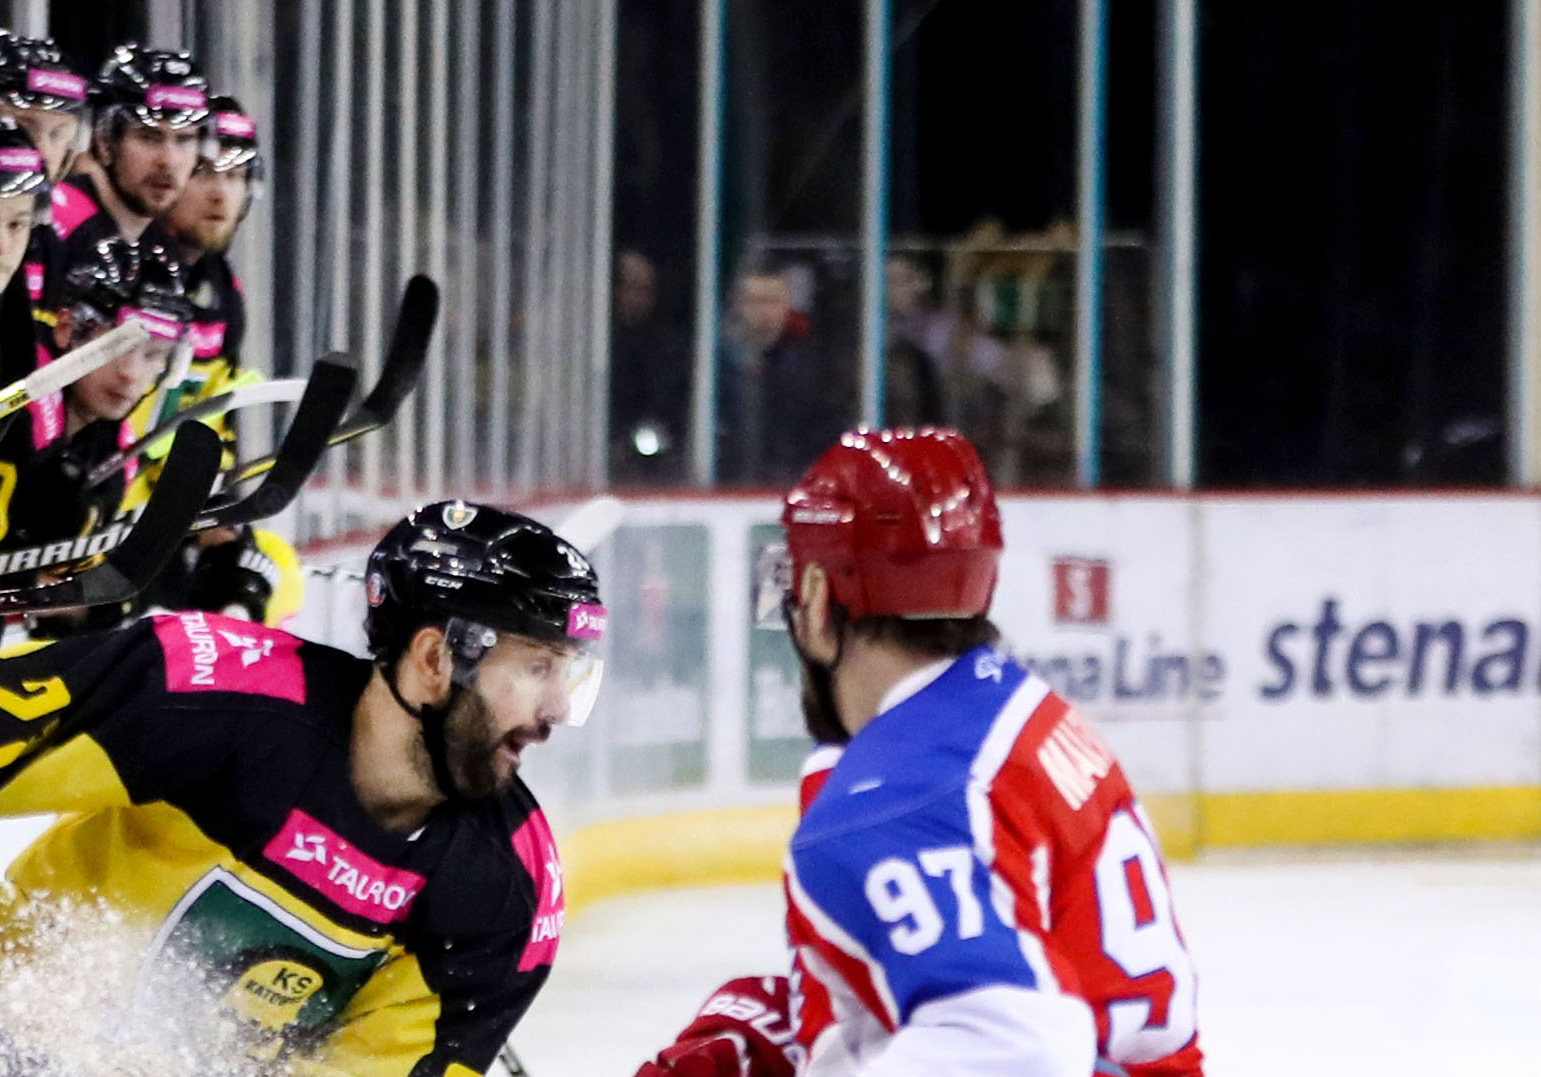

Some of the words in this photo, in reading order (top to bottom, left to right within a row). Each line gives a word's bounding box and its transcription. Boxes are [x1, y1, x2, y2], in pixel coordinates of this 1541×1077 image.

[424, 575, 464, 590] CCM
[180, 611, 219, 685] TAURON
[1257, 596, 1531, 700] stena
[865, 846, 985, 957] 97
[1094, 802, 1199, 1065] 9
[272, 966, 313, 994] KS
